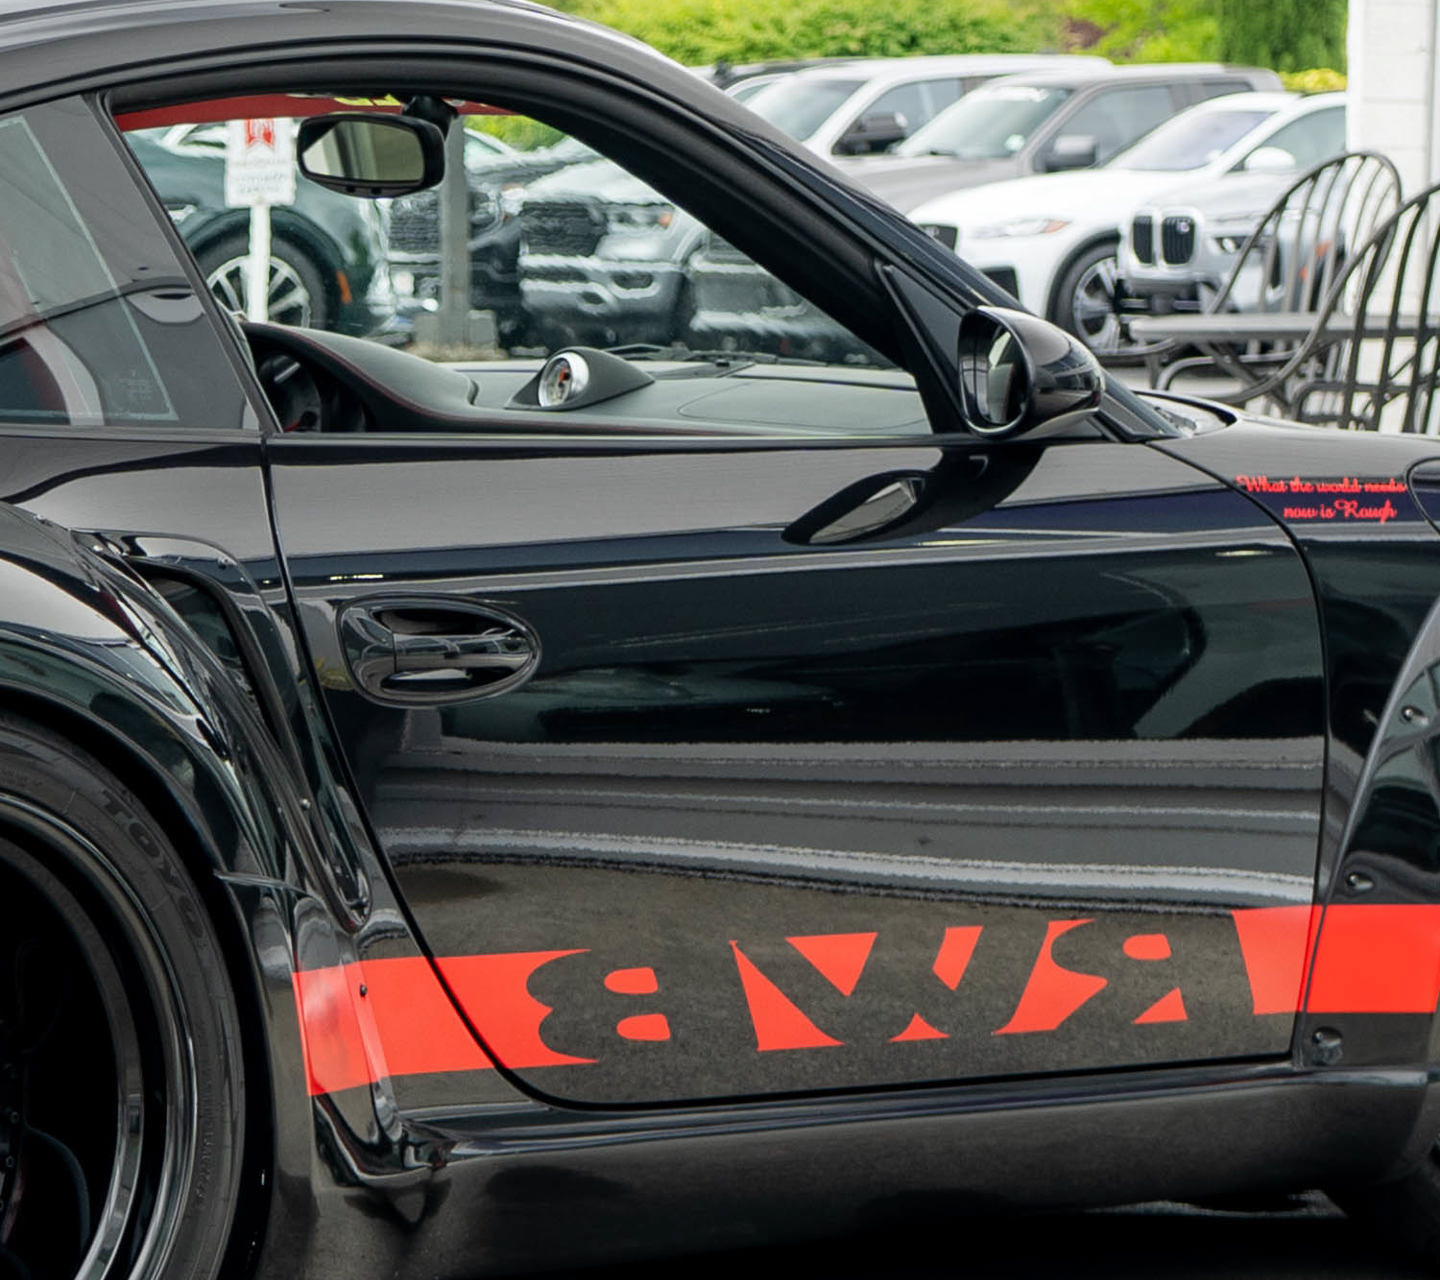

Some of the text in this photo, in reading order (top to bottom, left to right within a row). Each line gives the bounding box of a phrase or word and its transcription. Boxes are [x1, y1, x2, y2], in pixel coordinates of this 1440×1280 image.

[1236, 475, 1408, 494] What the world needs
[1283, 499, 1397, 524] now is Rough
